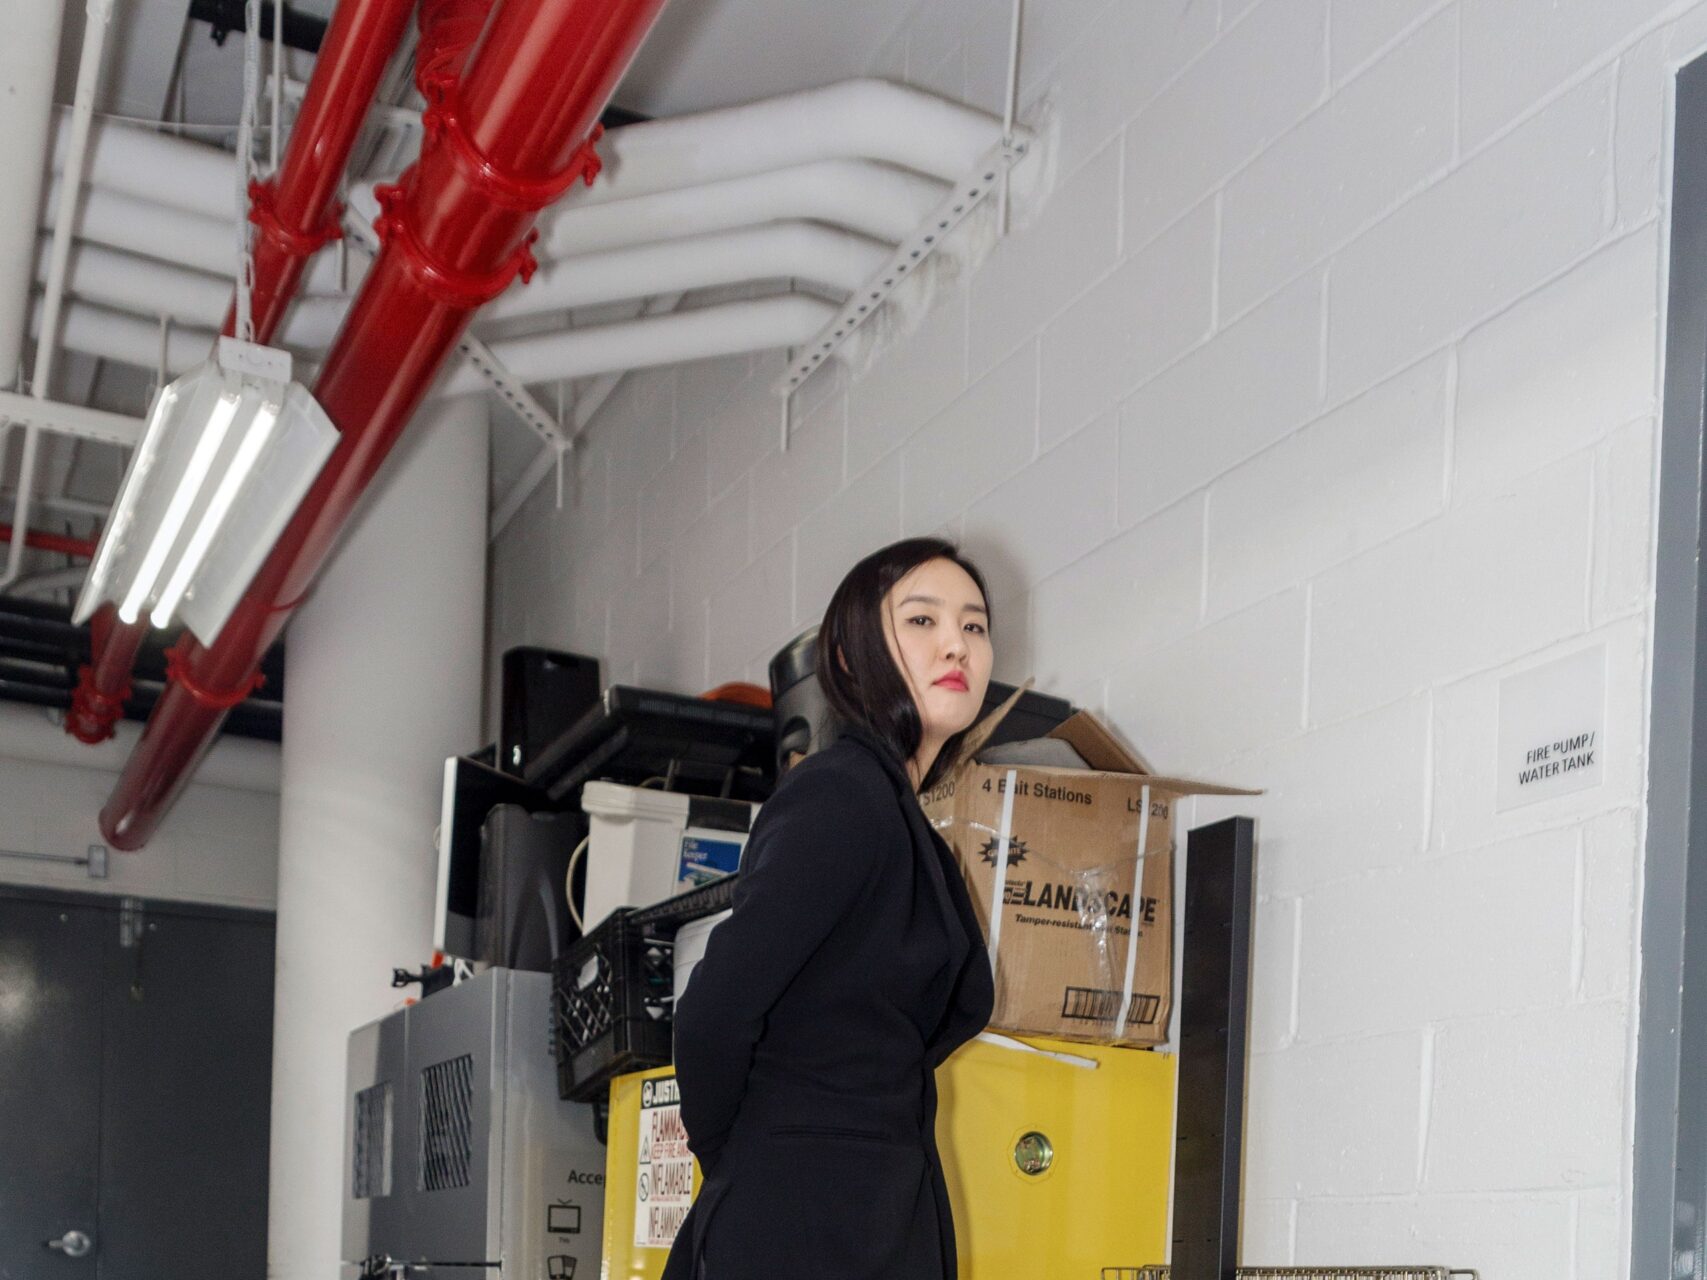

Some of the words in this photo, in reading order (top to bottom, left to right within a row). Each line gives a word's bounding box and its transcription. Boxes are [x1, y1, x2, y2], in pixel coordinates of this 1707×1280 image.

[1526, 745, 1551, 765] FIRE
[1518, 761, 1560, 785] WATER
[1562, 751, 1595, 773] TANK
[982, 779, 992, 793] 4
[1033, 782, 1093, 805] Stations
[1127, 797, 1169, 820] LS200
[568, 1169, 606, 1187] Acce
